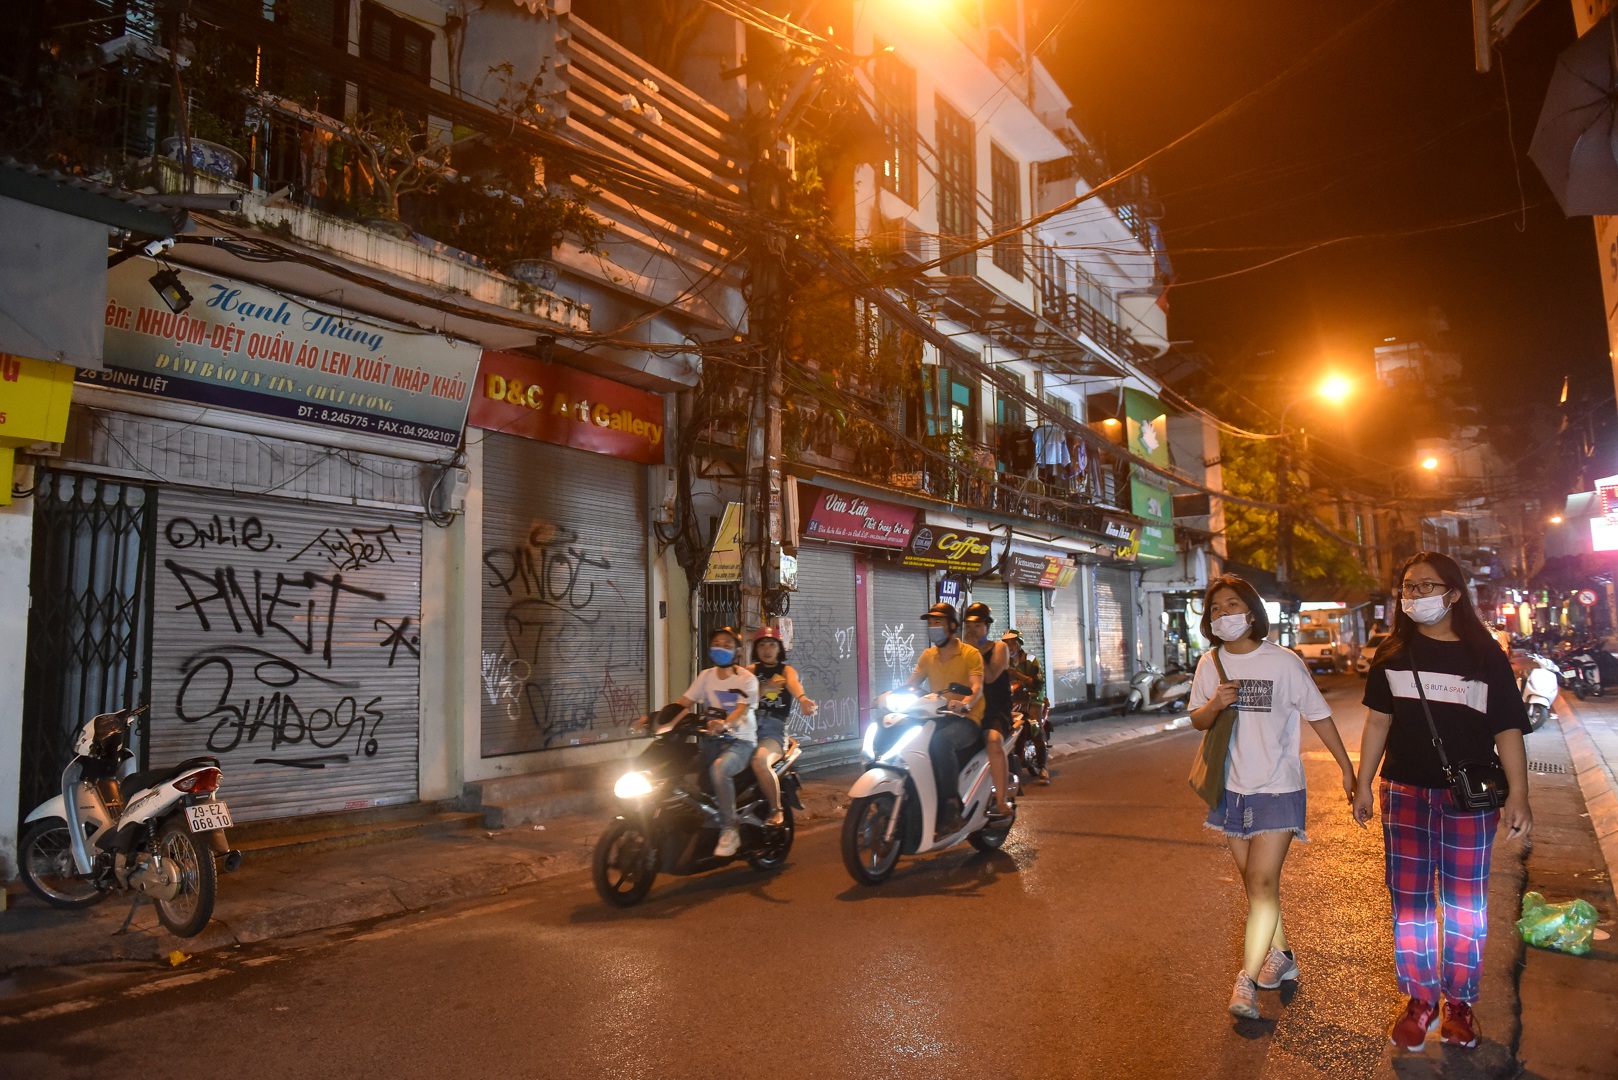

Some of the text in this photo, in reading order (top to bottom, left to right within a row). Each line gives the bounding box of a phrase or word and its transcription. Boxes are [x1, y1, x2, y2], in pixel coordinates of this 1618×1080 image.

[205, 284, 384, 352] Hạnh Thắng
[155, 351, 198, 374] ĐẢM
[200, 360, 237, 382] BẢO
[241, 370, 264, 387] UY
[247, 330, 294, 365] QUẦN
[295, 340, 319, 370] ÁO
[321, 349, 351, 377] LEN
[352, 355, 392, 385] XUẤT
[392, 367, 429, 397] NHẬP
[431, 372, 467, 402] KHẨU
[143, 376, 169, 393] LIỆT
[321, 410, 368, 428] 8.245775
[485, 374, 544, 410] D&C
[591, 403, 663, 446] Gallery
[936, 533, 990, 559] Coffee
[942, 580, 956, 595] LEN
[1430, 683, 1443, 691] BUT
[1449, 686, 1466, 694] SPAN
[192, 815, 230, 831] 068.10
